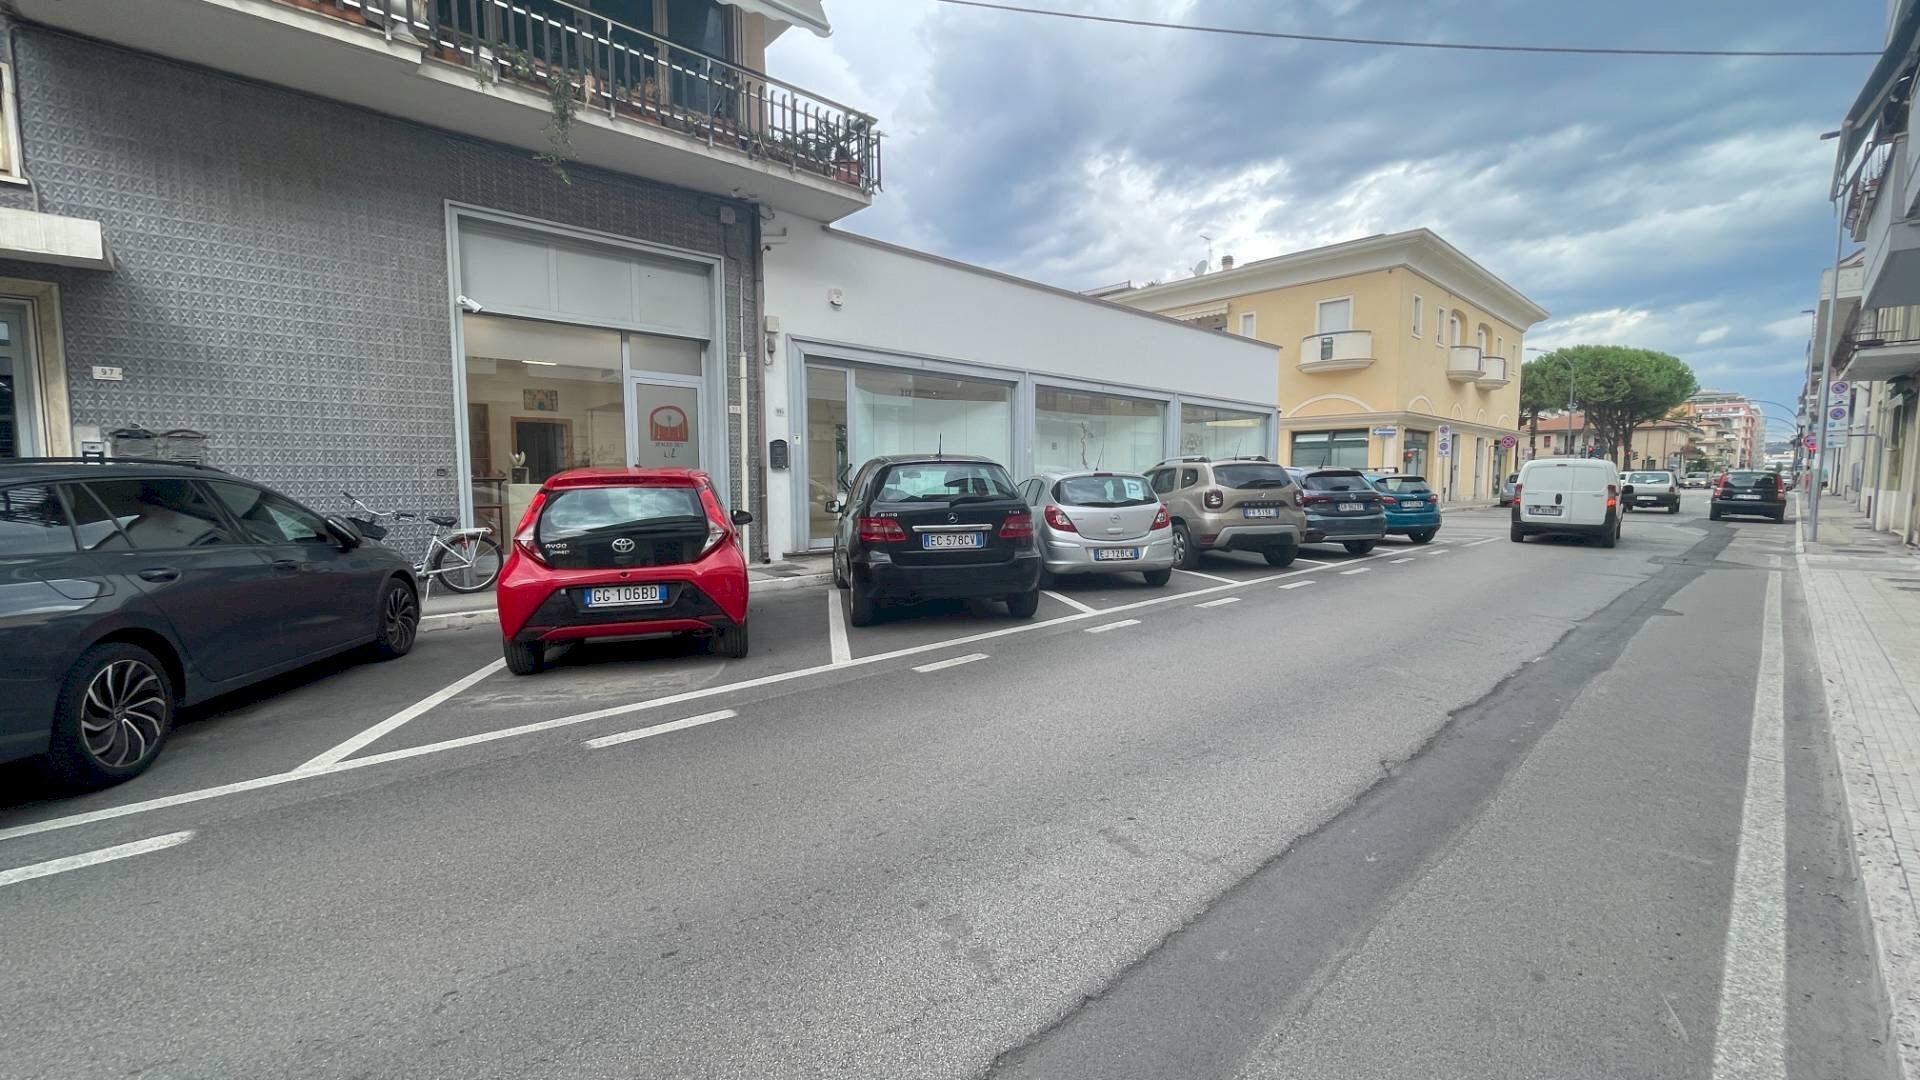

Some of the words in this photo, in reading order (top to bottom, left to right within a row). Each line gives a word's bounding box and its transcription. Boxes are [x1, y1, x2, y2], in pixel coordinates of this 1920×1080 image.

[1127, 482, 1140, 495] P
[930, 534, 943, 547] EC
[946, 534, 976, 547] 578CV
[593, 588, 611, 603] GG
[616, 586, 658, 602] 106BD
